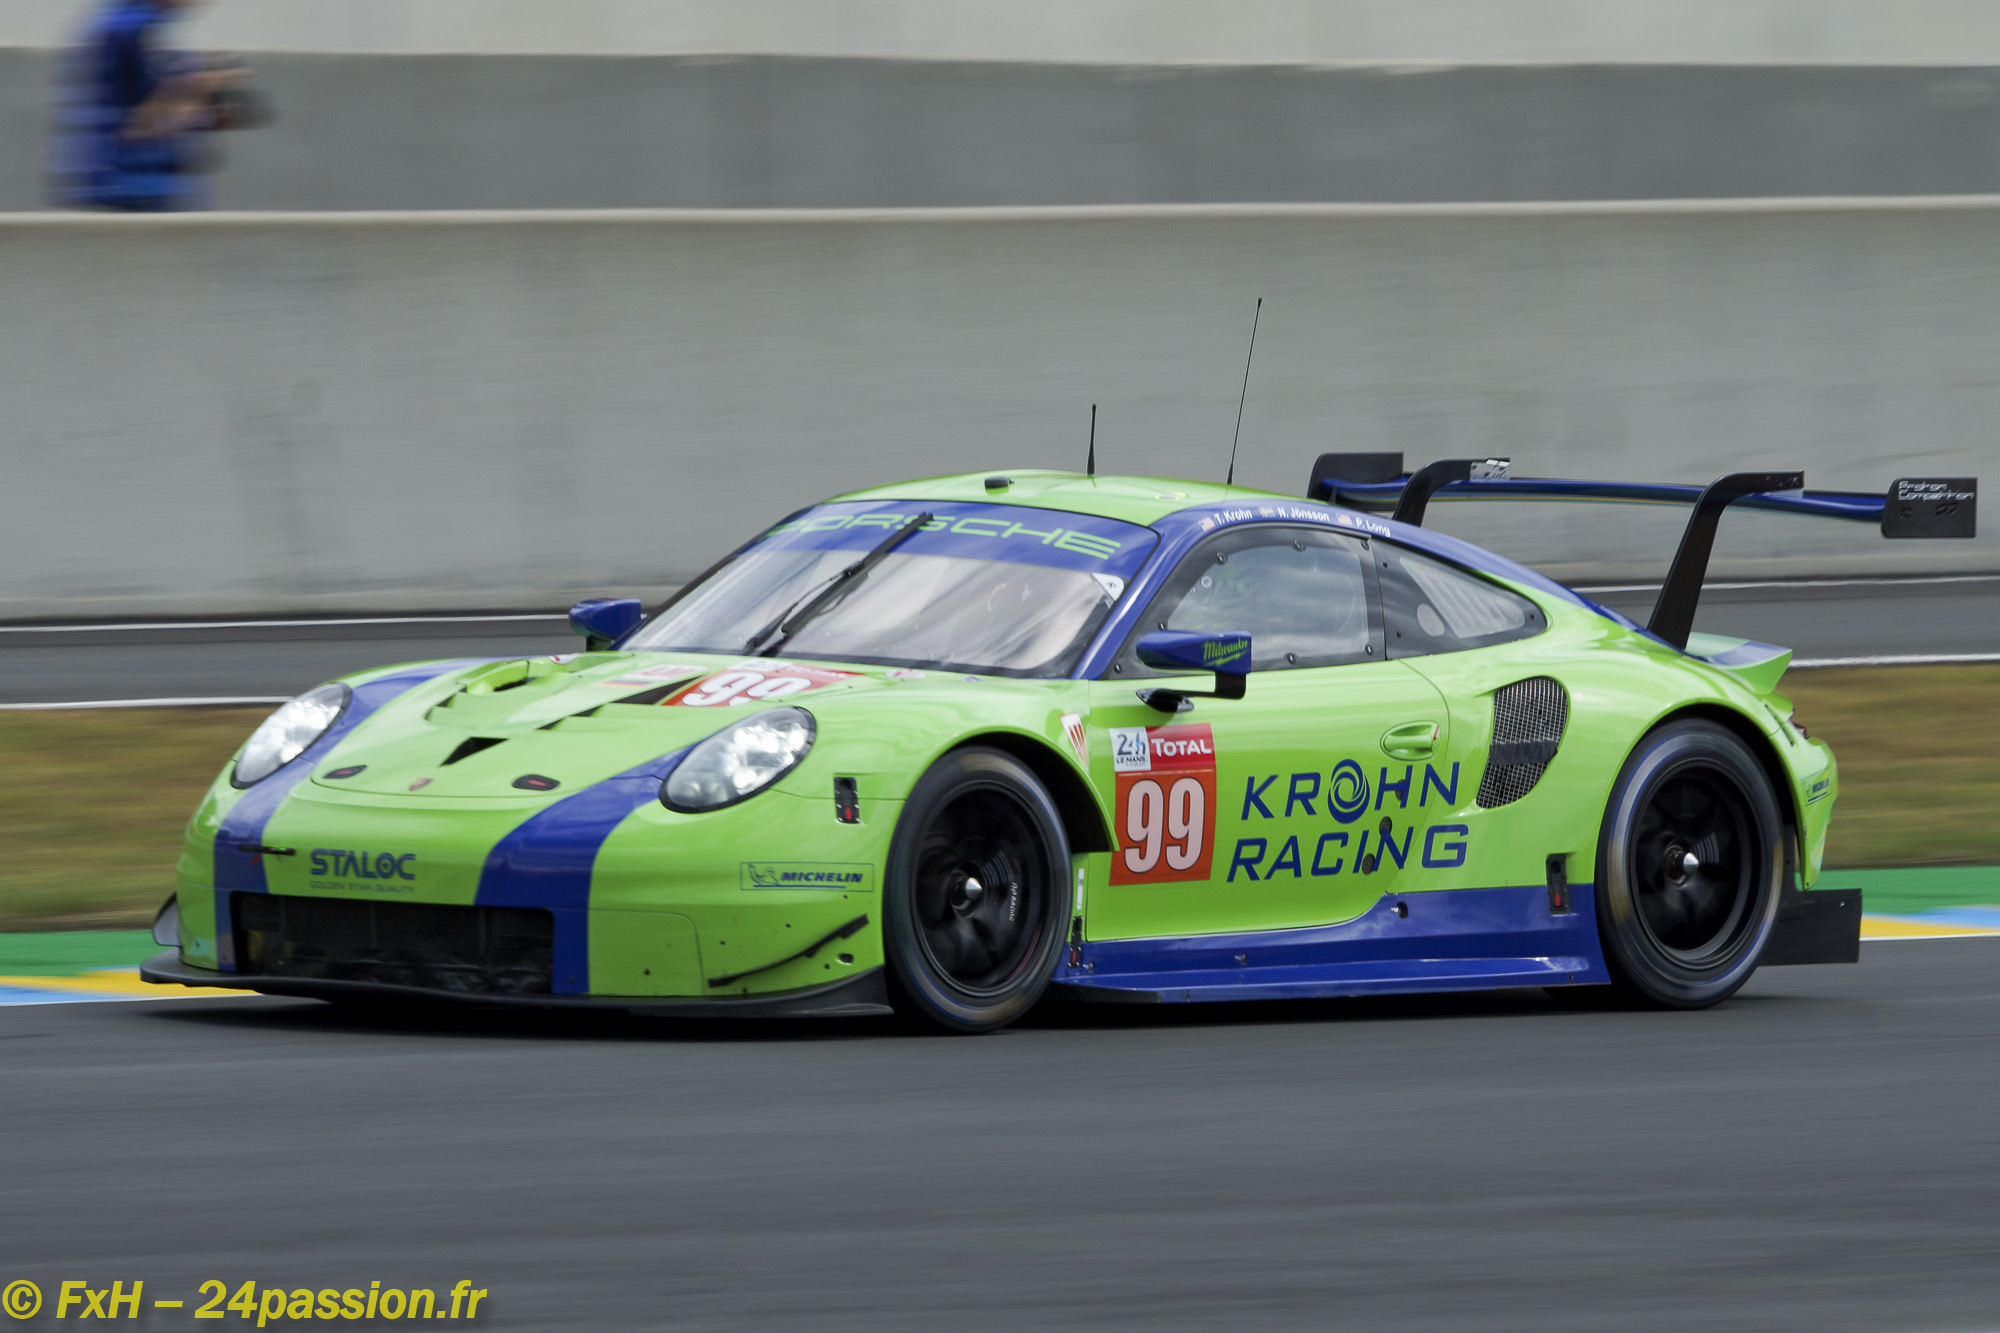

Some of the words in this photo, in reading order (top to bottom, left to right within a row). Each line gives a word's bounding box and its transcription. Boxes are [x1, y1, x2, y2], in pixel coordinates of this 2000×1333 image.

[1224, 507, 1254, 523] Krohn
[1278, 506, 1289, 519] N.
[1355, 517, 1365, 529] P.
[1365, 518, 1391, 538] Long
[1202, 638, 1249, 661] Milwaukee
[1150, 737, 1212, 757] TOTAL
[1240, 759, 1460, 825] KROHN
[1124, 776, 1206, 874] 99
[310, 848, 417, 881] STALOC
[1226, 824, 1469, 883] RACING
[780, 871, 864, 883] MICHELIN
